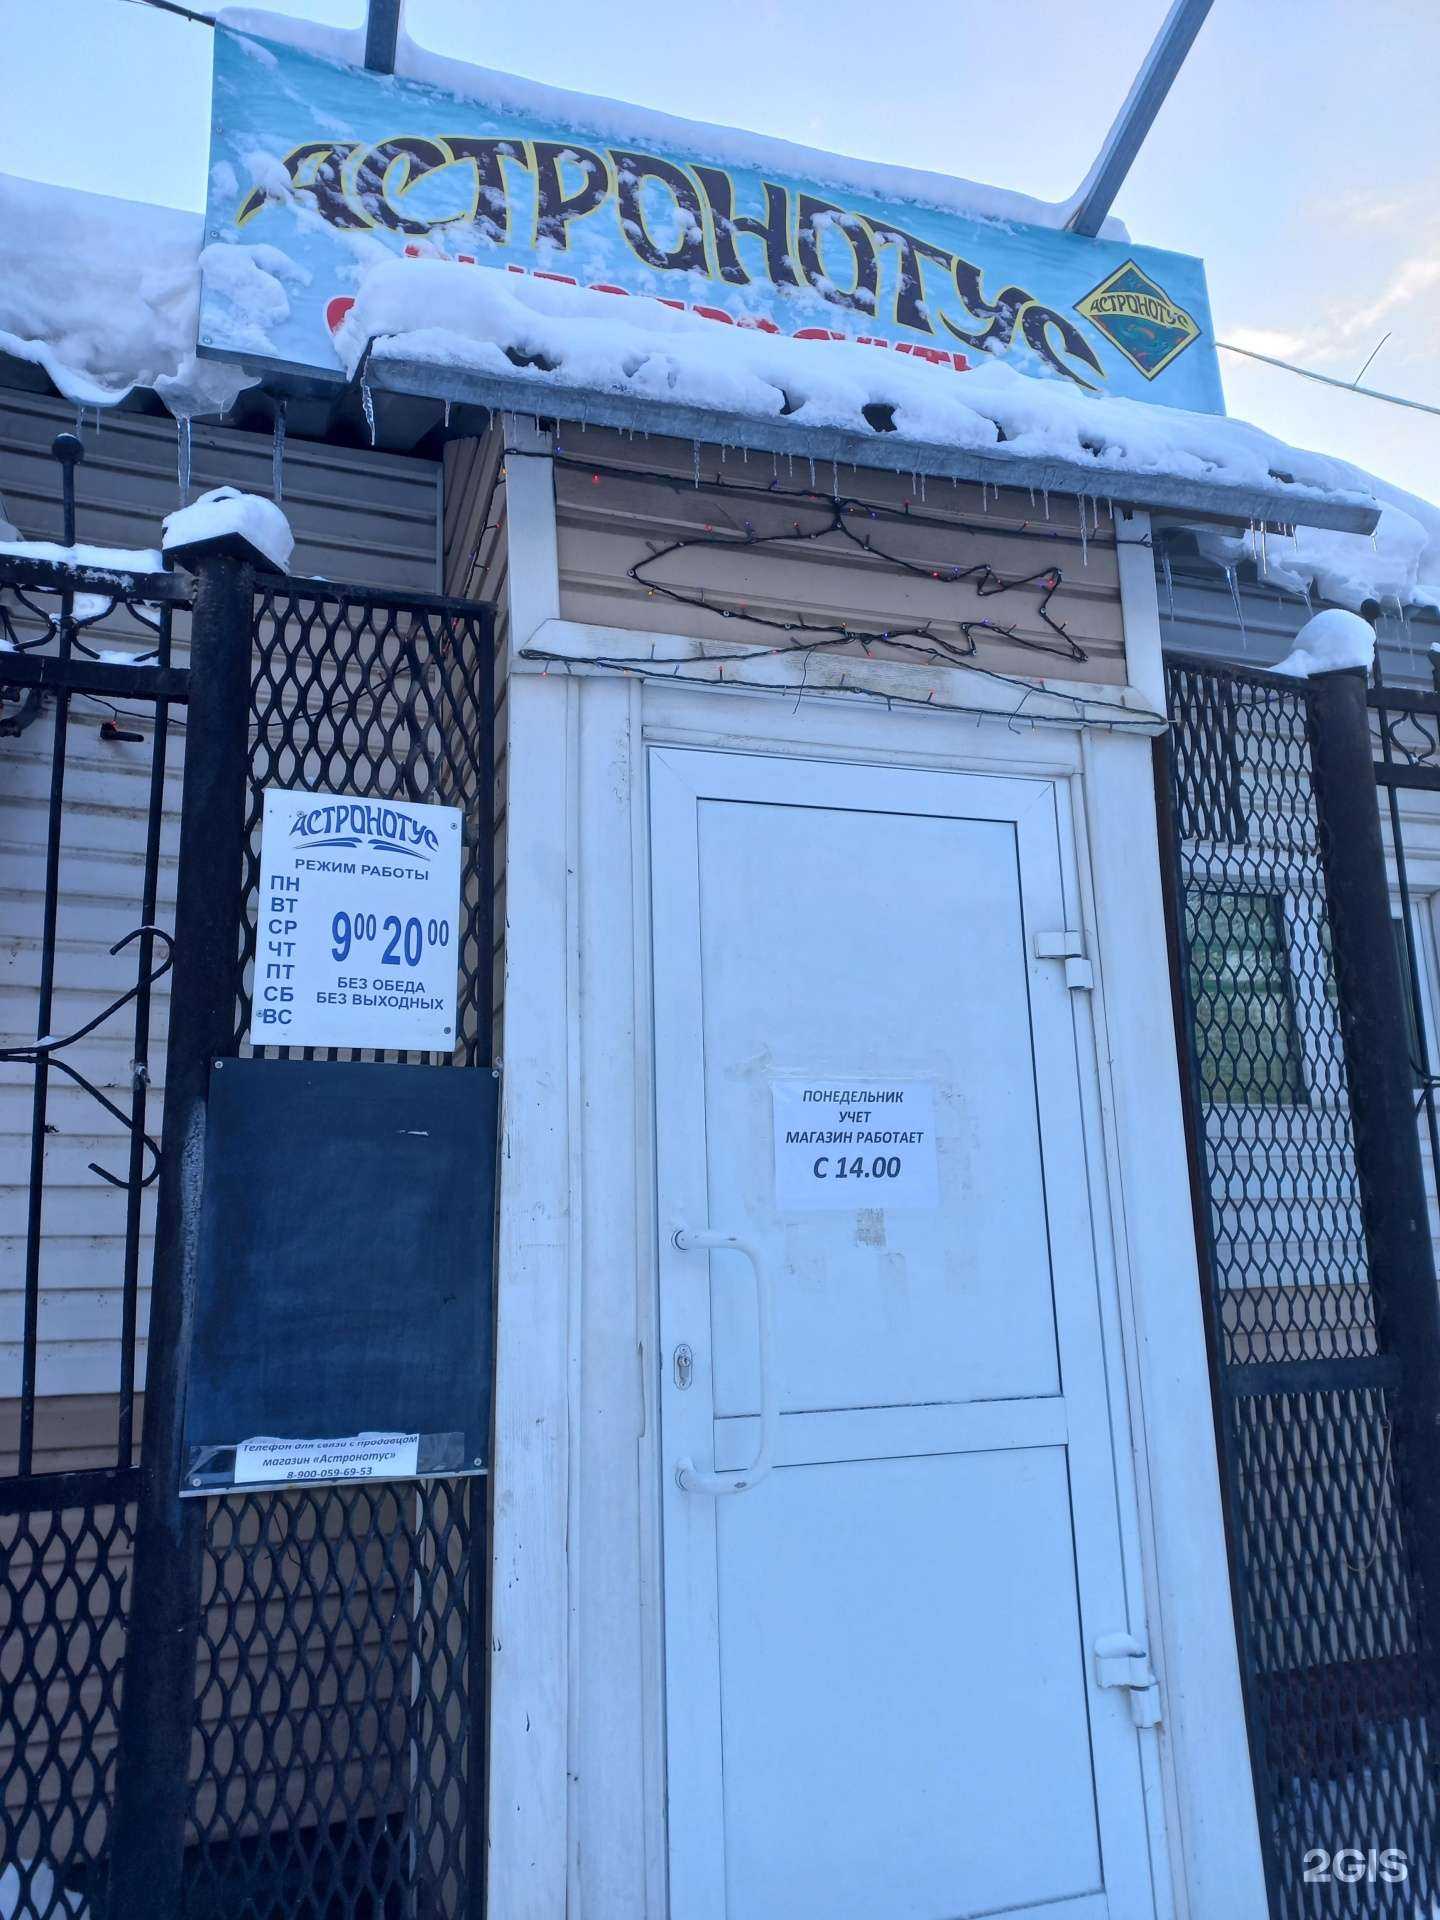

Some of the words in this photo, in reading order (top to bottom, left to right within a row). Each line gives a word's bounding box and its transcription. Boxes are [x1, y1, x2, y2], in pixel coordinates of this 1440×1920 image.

[236, 135, 1106, 393] АСТРОНОТУС
[1090, 294, 1189, 328] АСТРОНОТУС
[289, 804, 439, 852] АСТРОНОТУС
[295, 859, 356, 874] РЕЖИМ
[361, 864, 429, 881] РАБОТЫ
[270, 875, 300, 892] ПН
[271, 897, 298, 913] ВТ
[268, 919, 298, 935] СР
[268, 941, 296, 957] ЧТ
[266, 964, 295, 980] ПТ
[337, 977, 367, 989] БЕЗ
[373, 979, 426, 994] ОБЕДА
[263, 986, 294, 1002] СБ
[316, 992, 347, 1004] БЕЗ
[352, 993, 444, 1010] ВЫХОДНЫХ
[263, 1009, 292, 1025] ВС
[802, 1090, 904, 1105] ПОНЕДЕЛЬНИК
[838, 1111, 871, 1123] УЧЕТ
[786, 1131, 852, 1144] МАГАЗИН
[856, 1131, 924, 1144] РАБОТАЕТ
[813, 1157, 829, 1178] С
[835, 1157, 901, 1178] 14.00
[262, 1456, 311, 1467] магазин
[313, 1451, 396, 1464] «Астронотус»
[286, 1466, 373, 1479] 8-900-059-69-53
